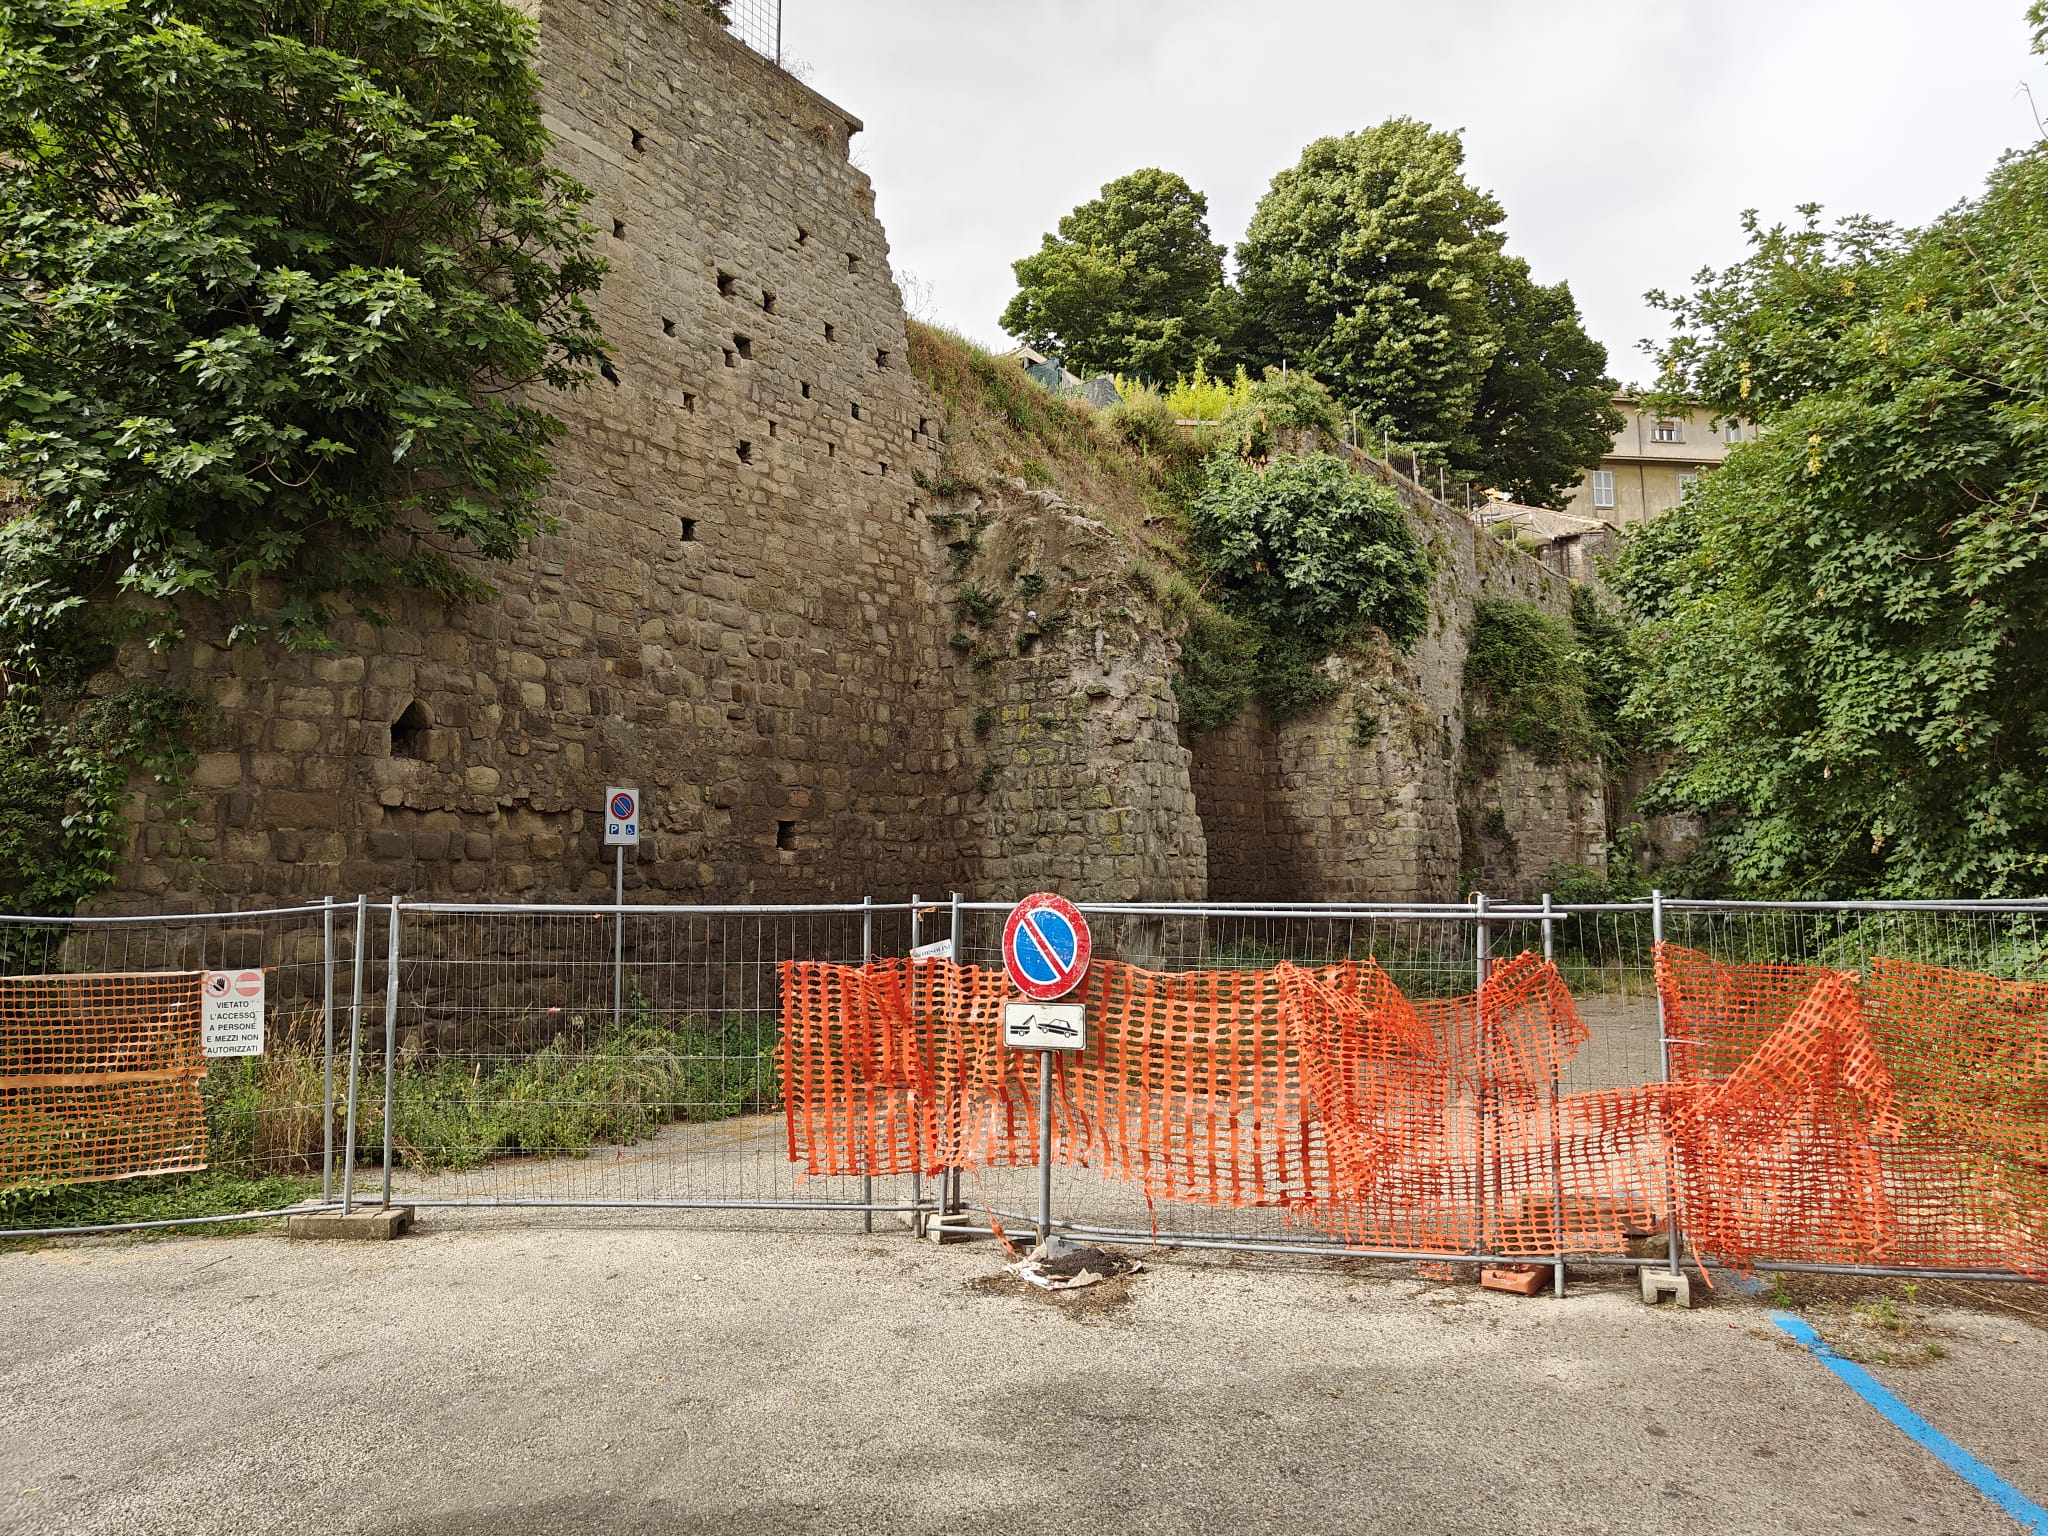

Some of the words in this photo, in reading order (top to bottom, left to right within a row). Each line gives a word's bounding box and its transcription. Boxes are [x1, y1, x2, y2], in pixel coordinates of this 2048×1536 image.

[610, 825, 618, 833] P
[210, 1012, 256, 1020] L'ACCESSO
[214, 1034, 238, 1042] MEZZI
[207, 1046, 258, 1054] AUTORIZZATI
